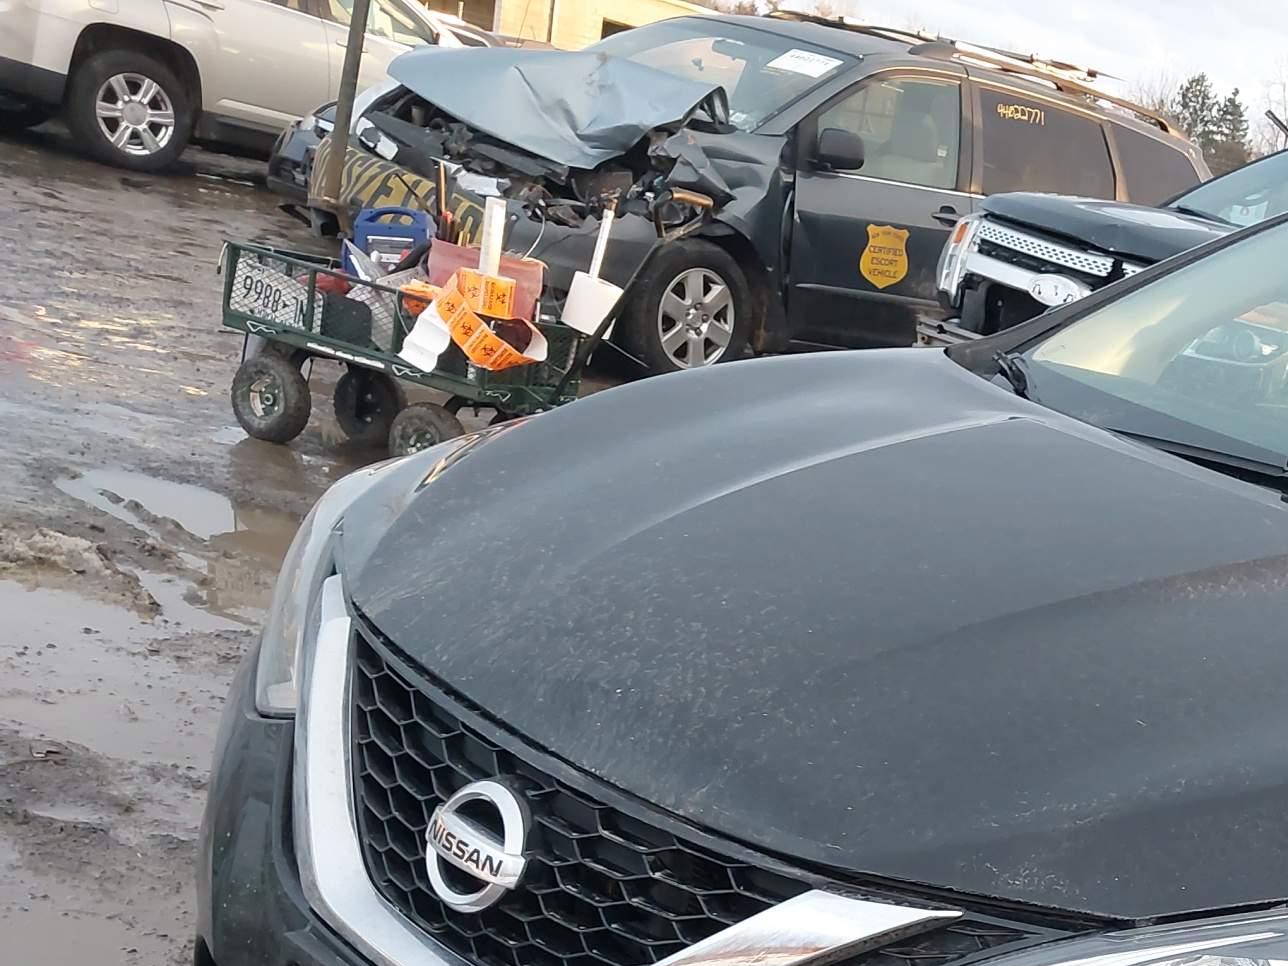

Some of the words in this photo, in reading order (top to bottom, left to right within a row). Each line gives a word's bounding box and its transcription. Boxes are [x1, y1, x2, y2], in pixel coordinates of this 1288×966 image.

[869, 244, 904, 257] CERTIFIED
[871, 256, 898, 267] ESCORT
[428, 819, 504, 878] NISSAN
